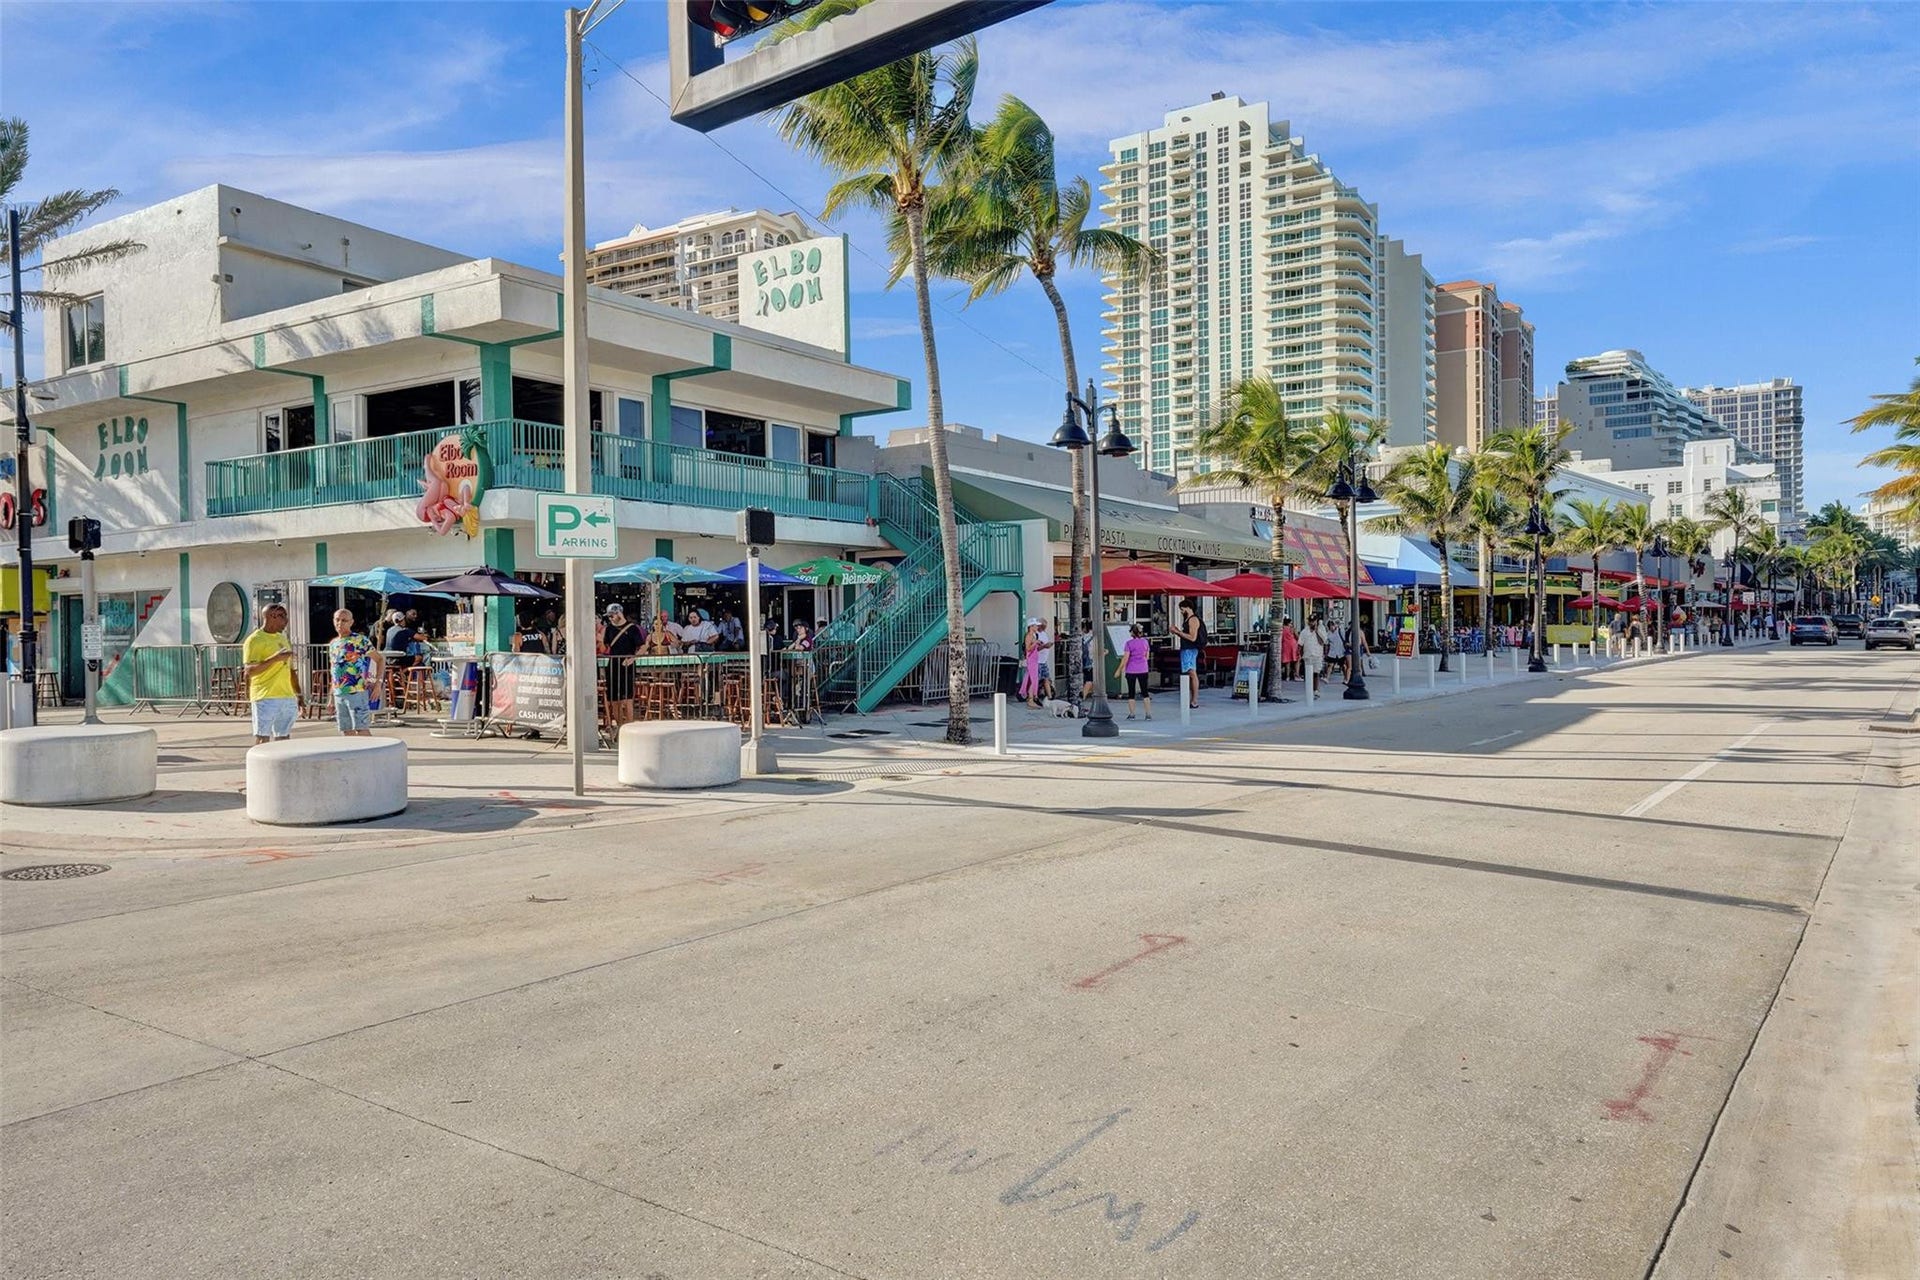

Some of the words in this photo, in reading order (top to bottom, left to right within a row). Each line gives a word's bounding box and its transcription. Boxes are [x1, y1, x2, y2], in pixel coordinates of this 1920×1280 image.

[752, 247, 822, 287] ELBO
[755, 276, 823, 317] ROOM
[97, 415, 149, 451] ELBO
[445, 463, 478, 478] Room
[1063, 523, 1090, 542] PIA
[1100, 529, 1127, 546] PASTA
[1157, 536, 1196, 553] COCKTAILS
[1201, 542, 1221, 556] WINE
[686, 556, 698, 565] 241
[842, 572, 882, 585] Heineken
[518, 710, 537, 719] CASH
[538, 712, 559, 721] ONLY
